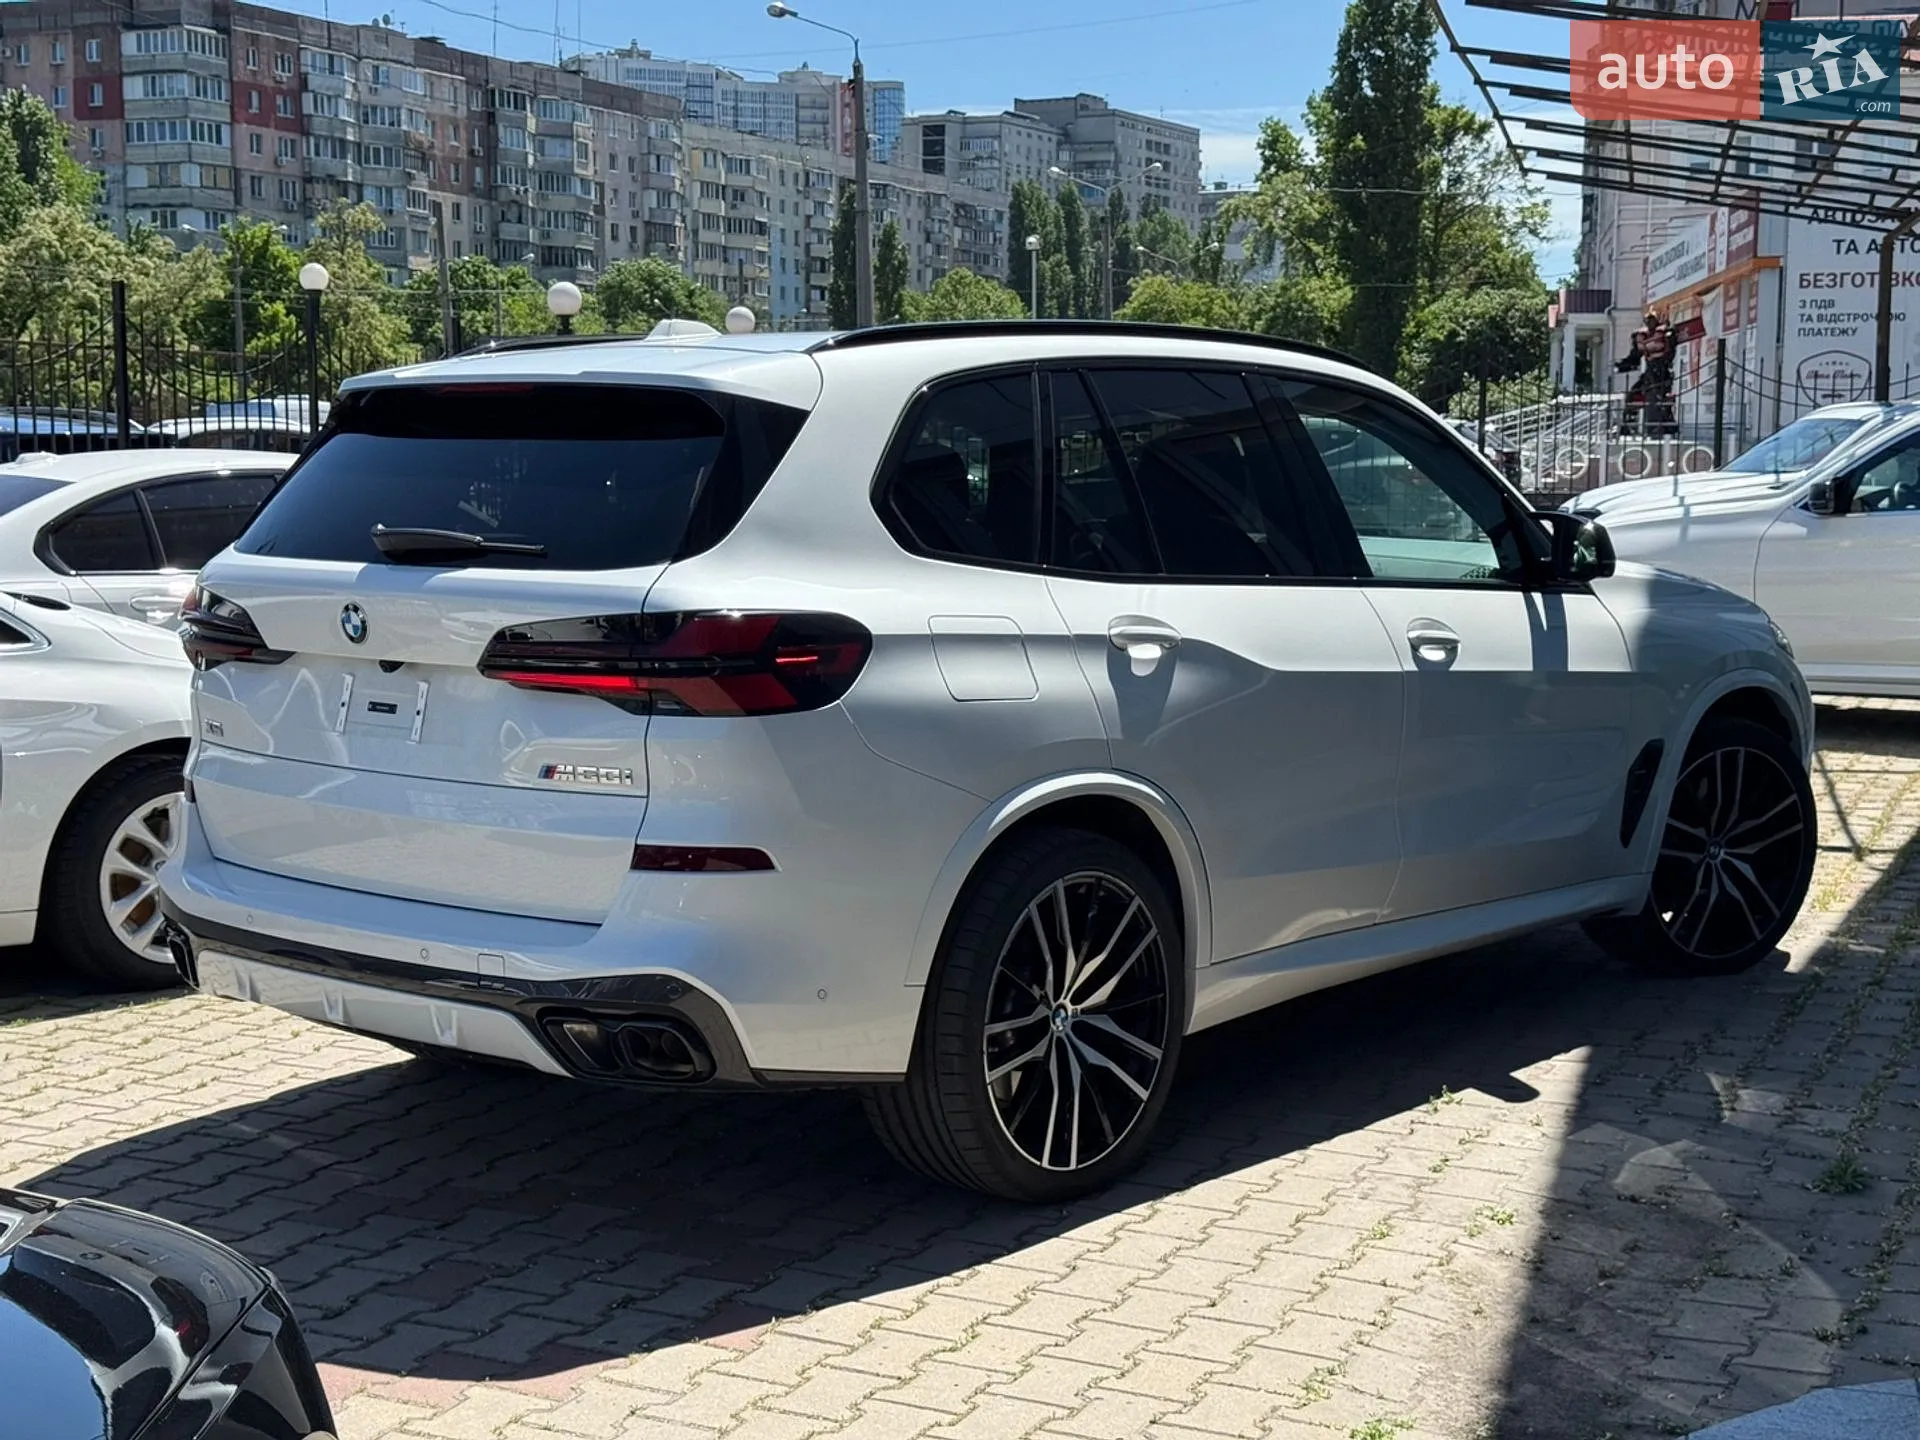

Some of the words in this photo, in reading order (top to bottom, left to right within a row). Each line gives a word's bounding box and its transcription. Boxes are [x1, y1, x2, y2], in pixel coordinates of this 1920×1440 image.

[1832, 239, 1859, 255] ТА
[1866, 238, 1920, 255] АТО
[1799, 271, 1920, 289] БЕЗГОТВК
[1809, 299, 1836, 310] ПДВ
[1798, 313, 1814, 324] ТА
[1797, 327, 1859, 338] ПЛАТЕЖУ
